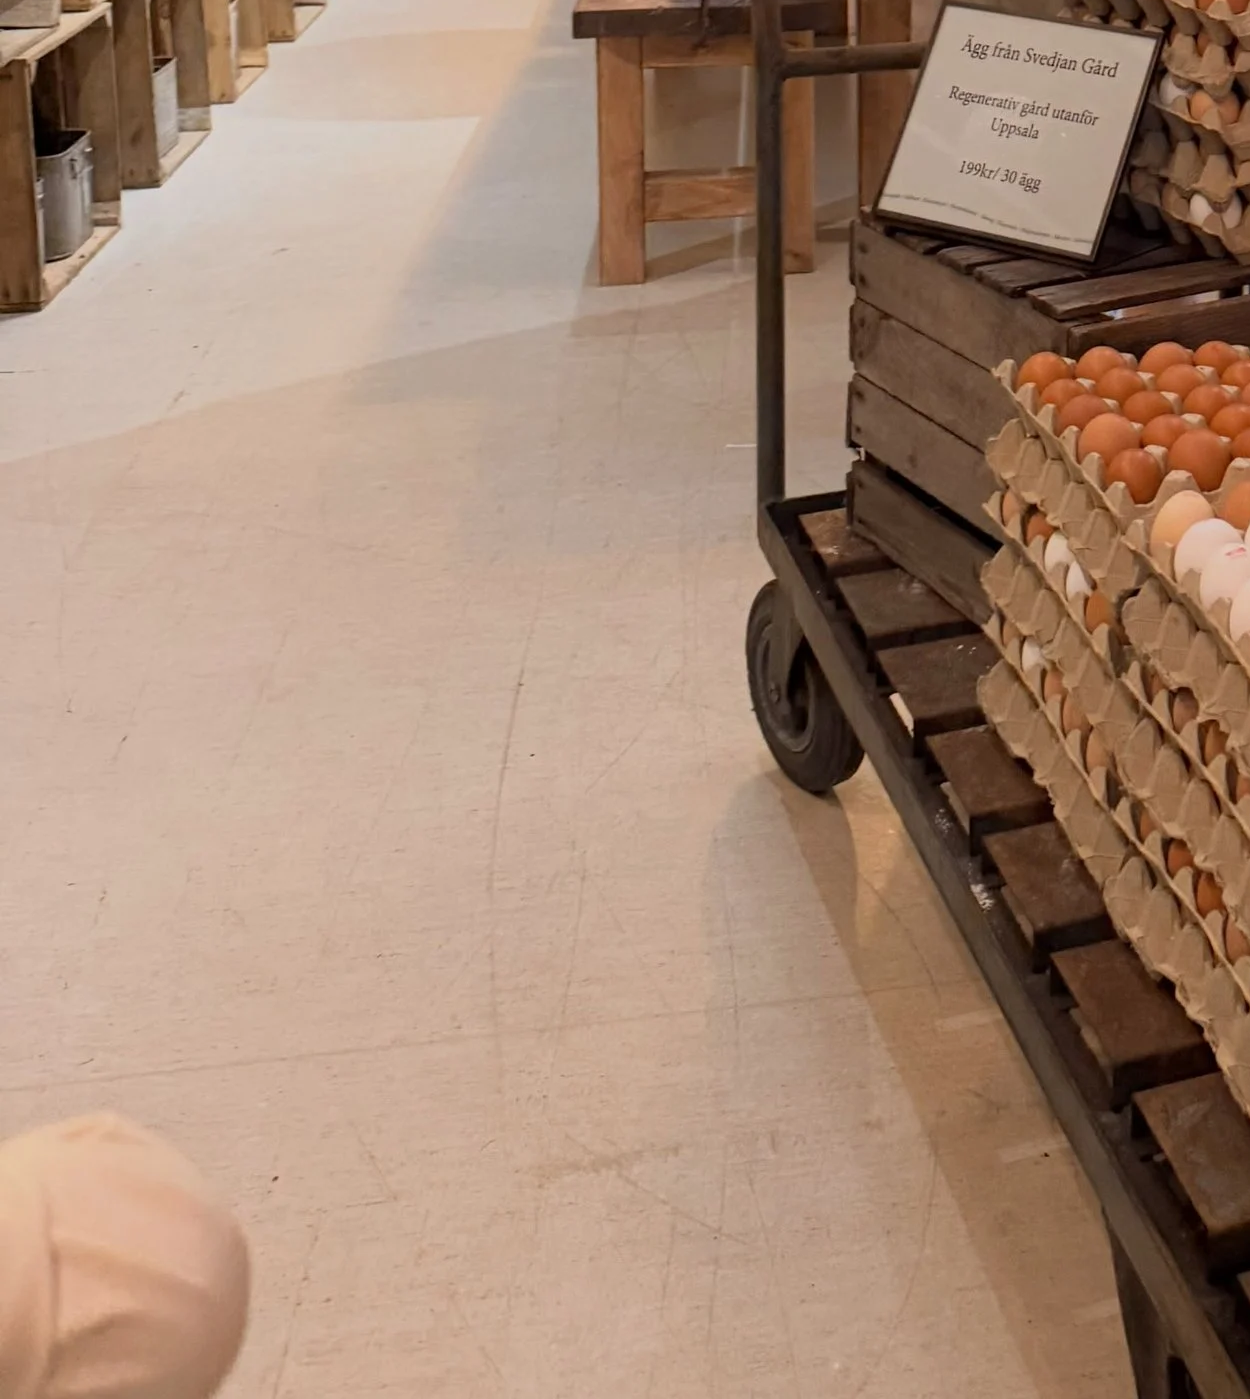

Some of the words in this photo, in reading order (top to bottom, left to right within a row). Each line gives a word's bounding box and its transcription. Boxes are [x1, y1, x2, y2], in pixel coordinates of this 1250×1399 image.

[960, 35, 989, 60] Ägg
[991, 41, 1020, 61] från
[1024, 47, 1077, 73] Svedjan
[1081, 57, 1119, 78] Gård
[949, 85, 1019, 112] Regenerativ
[1020, 101, 1049, 118] gård
[1052, 107, 1100, 126] utanför
[990, 117, 1040, 141] Uppsala
[959, 160, 999, 180] 199kr/
[1000, 168, 1017, 184] 30
[1018, 172, 1041, 193] ägg
